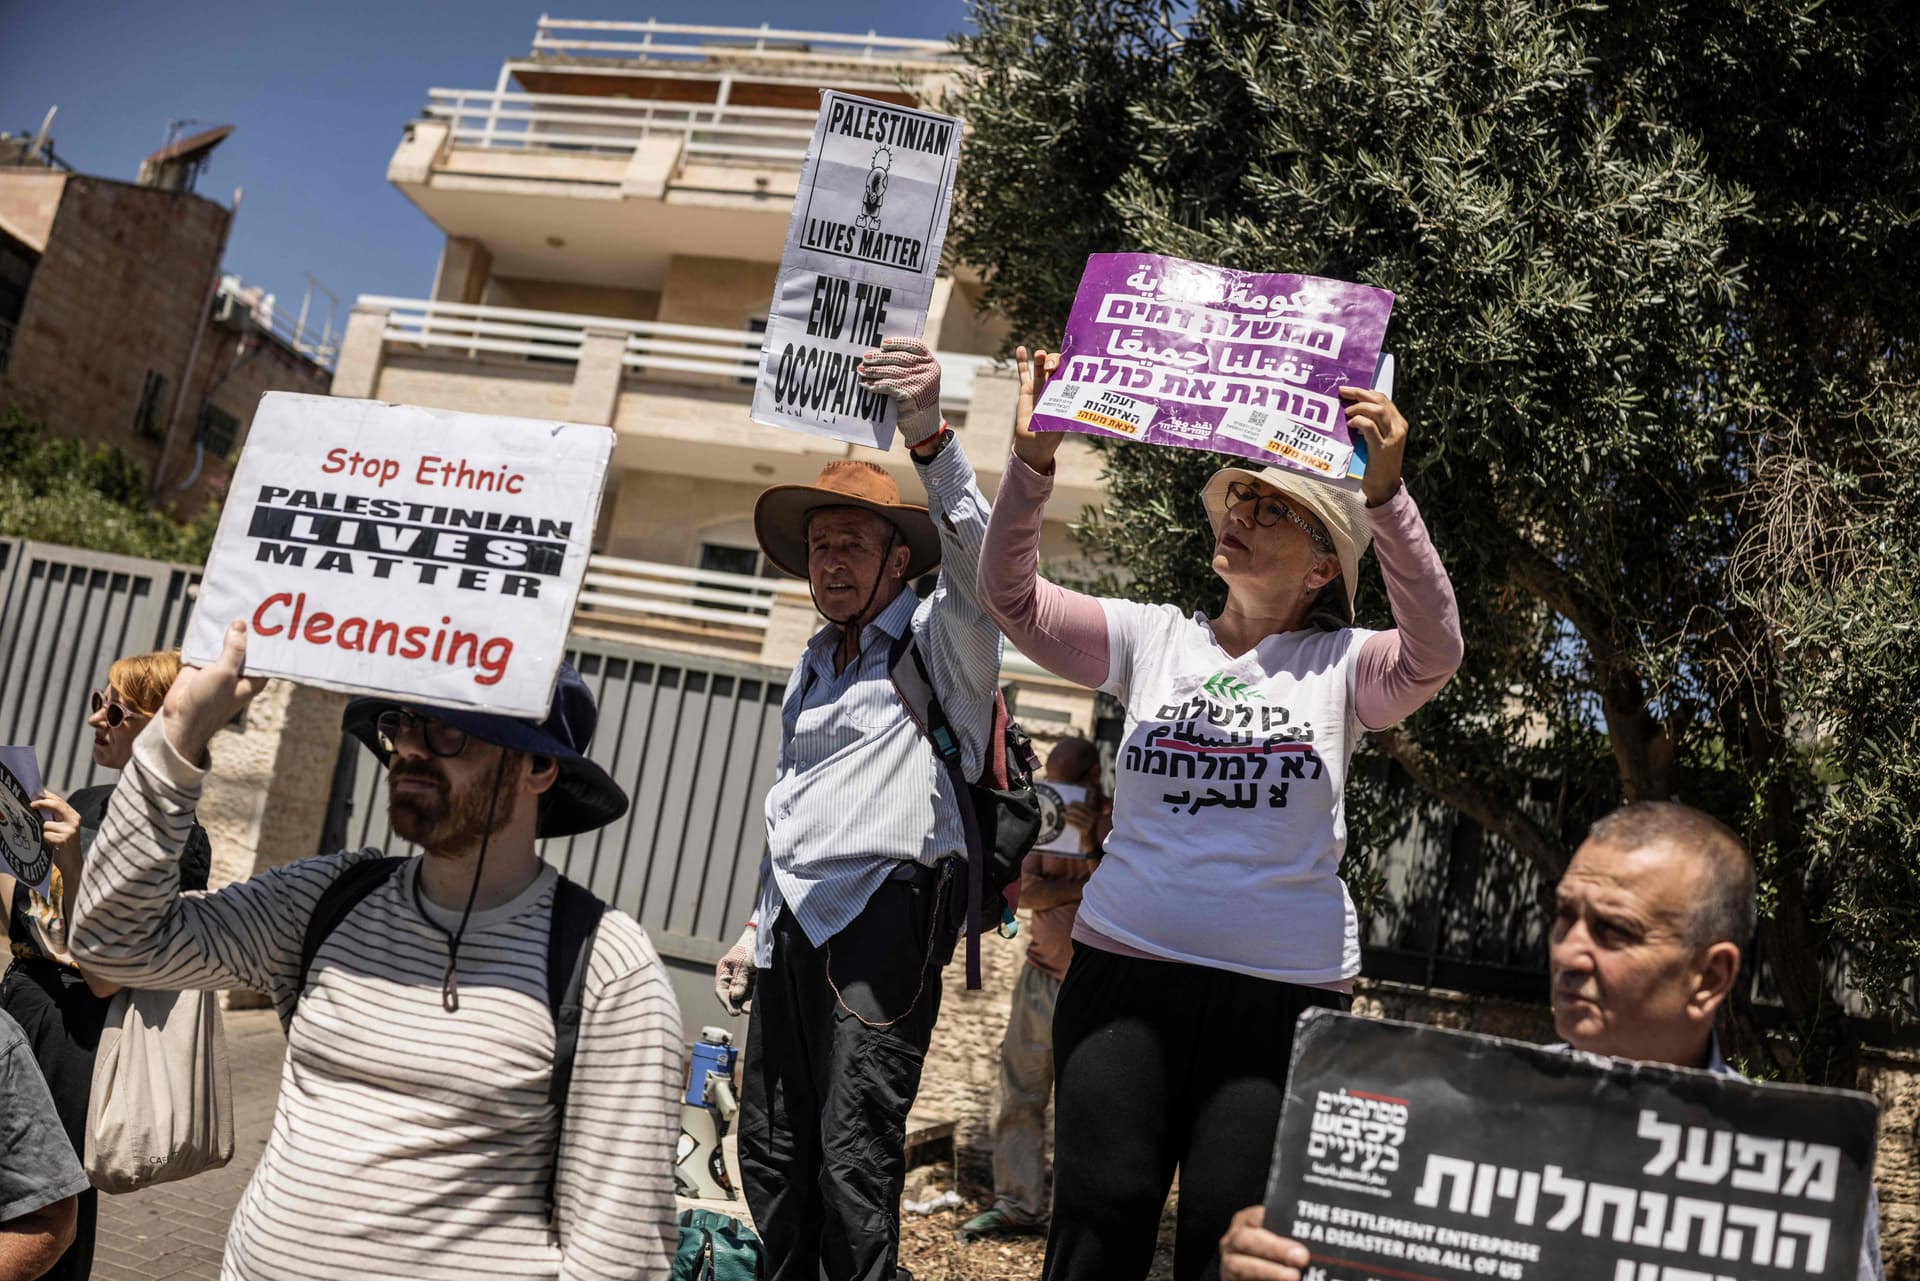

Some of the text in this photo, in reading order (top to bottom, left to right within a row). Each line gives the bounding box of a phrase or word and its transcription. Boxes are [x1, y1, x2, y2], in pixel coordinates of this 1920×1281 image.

[829, 102, 950, 156] PALESTINIAN
[807, 218, 922, 268] LIVES MATTER
[806, 275, 892, 348] END THE
[1106, 299, 1334, 352] ממשלת דמים
[1069, 356, 1331, 425] הורגת את כולנו
[321, 447, 525, 495] Stop Ethnic
[257, 485, 573, 540] PALESTINIAN
[288, 514, 530, 568] LIVES
[255, 541, 542, 599] MATTER
[252, 592, 514, 686] Cleansing
[1155, 696, 1290, 732] כן לשלום
[1126, 745, 1323, 780] לא למלחמה
[1637, 1109, 1842, 1201] מפעל
[1297, 1199, 1541, 1262] THE SETTLEMENT ENTERPRISE
[1414, 1153, 1832, 1275] ההתנחלויות
[1292, 1220, 1524, 1280] IS A DISASTER FOR ALL OF US
